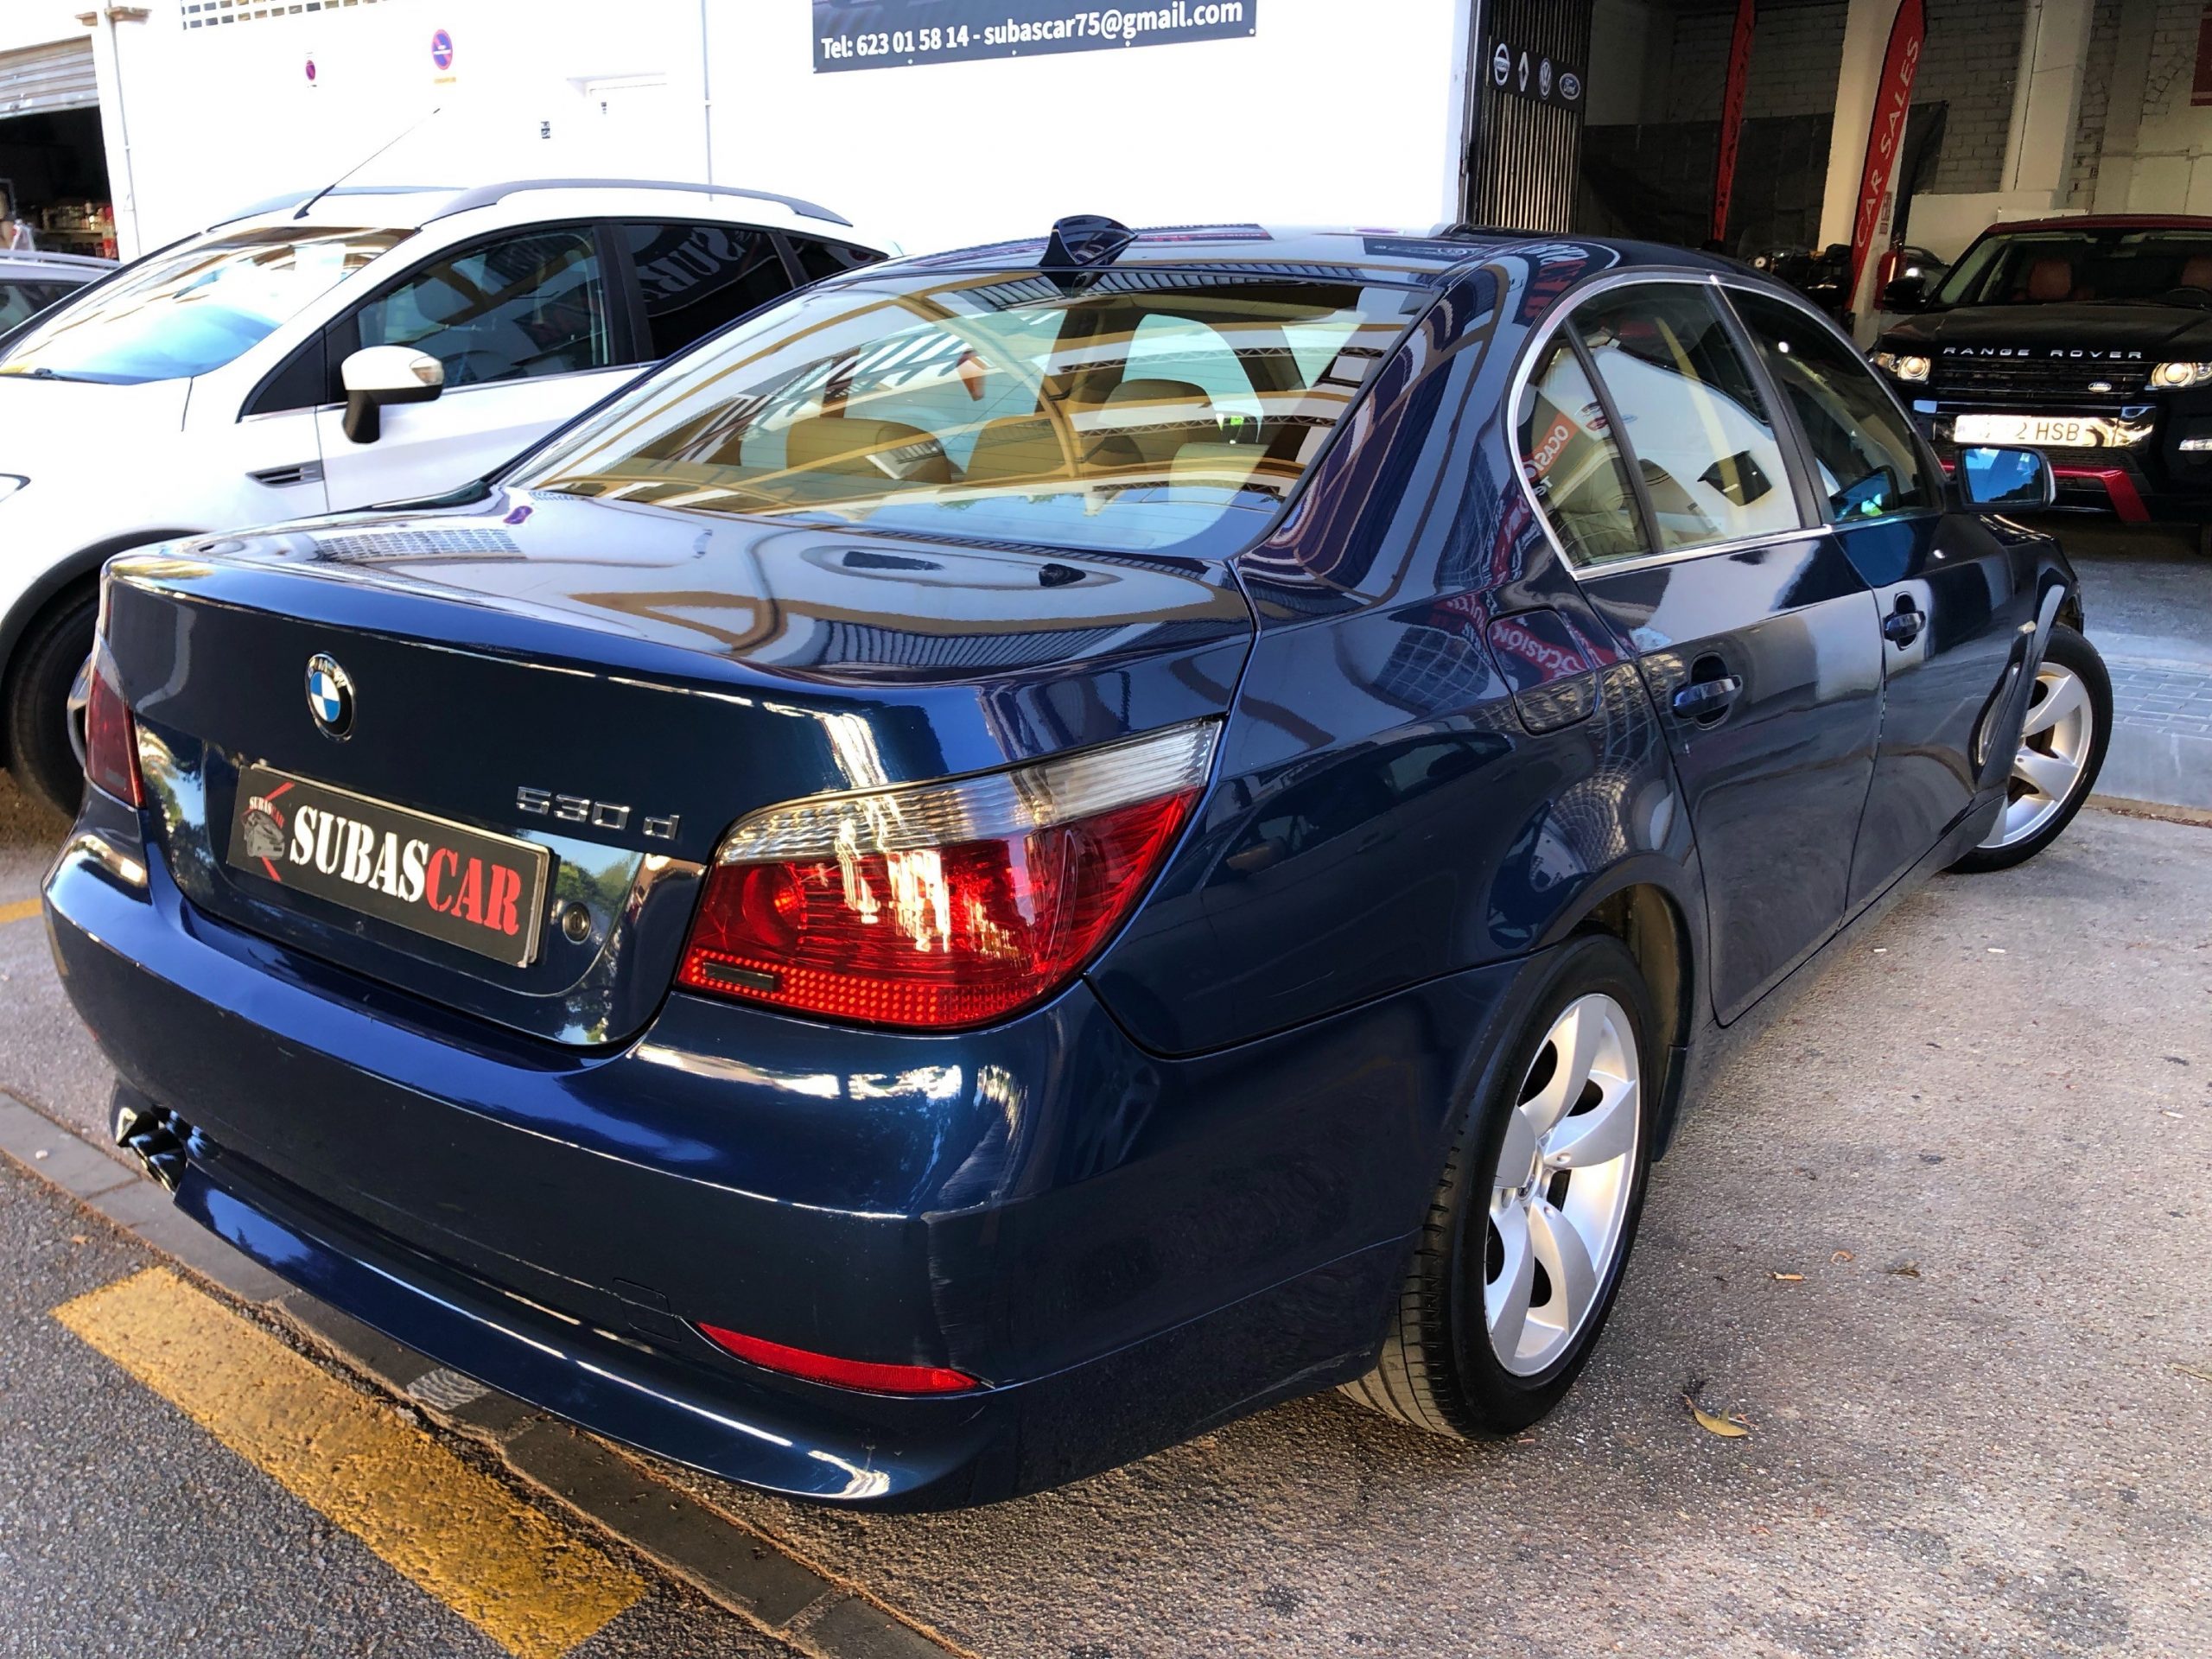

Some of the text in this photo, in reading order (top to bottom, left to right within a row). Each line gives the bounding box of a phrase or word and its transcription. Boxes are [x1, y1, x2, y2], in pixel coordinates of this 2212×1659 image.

[821, 35, 854, 59] Tel:
[856, 33, 889, 56] 623
[893, 30, 915, 53] 01
[918, 28, 942, 51] 58
[946, 25, 969, 48] 14
[983, 1, 1243, 45] subascar75@gmail.com
[1858, 168, 1883, 248] CAR
[1880, 36, 1919, 160] SALES
[1943, 346, 2142, 359] RANGE ROVER
[2036, 422, 2081, 442] HSB
[516, 785, 681, 841] 530 d
[289, 804, 522, 936] SUBASCAR
